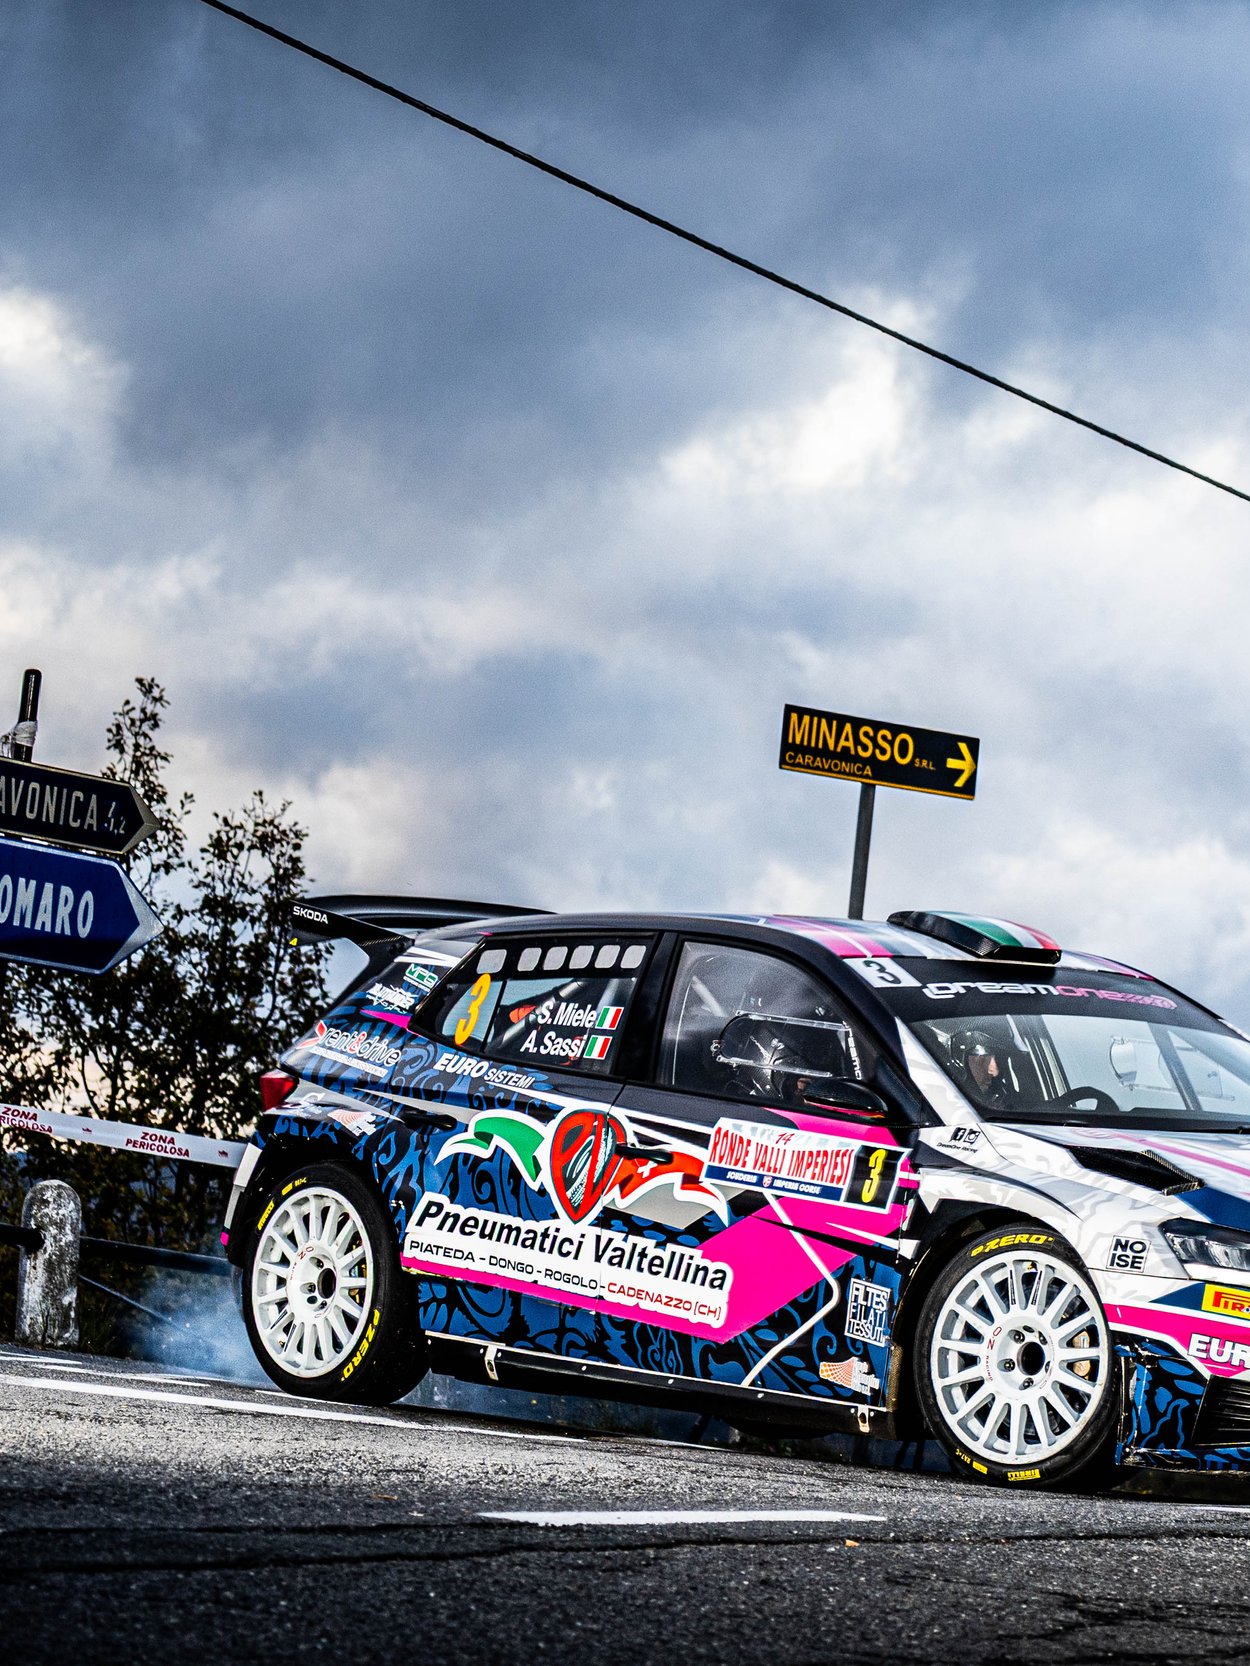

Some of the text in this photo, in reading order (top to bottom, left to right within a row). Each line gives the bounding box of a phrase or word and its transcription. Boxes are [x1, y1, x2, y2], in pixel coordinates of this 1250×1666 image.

[788, 713, 914, 765] MINASSO
[785, 752, 872, 777] CARAVONICA
[0, 874, 94, 939] OMARO
[293, 906, 328, 924] SKODA
[864, 959, 901, 985] 3
[454, 973, 491, 1046] 3
[538, 1002, 596, 1028] S. Miele
[323, 1028, 402, 1067] rent&drive
[520, 1030, 586, 1058] A. Sassi
[433, 1052, 536, 1089] EURO SISTEMI
[2, 1107, 39, 1122] ZONA
[125, 1138, 190, 1158] PERICOLOSA
[141, 1131, 176, 1145] ZONA
[775, 1132, 796, 1146] 14
[709, 1126, 855, 1186] RONDE VALLI IMPERIESI
[726, 1171, 822, 1195] SCUDERIA IMPERIA CORSE
[861, 1149, 887, 1203] 3
[415, 1200, 729, 1291] Pneumatici Valtellina
[1113, 1238, 1147, 1254] NO
[1109, 1252, 1144, 1271] ISE
[409, 1240, 476, 1263] PIATEDA
[488, 1255, 534, 1275] DONGO
[544, 1268, 598, 1290] ROGOLO
[607, 1282, 692, 1311] CADENAZZO
[850, 1302, 886, 1328] FILATI
[849, 1318, 883, 1343] TESSUTI
